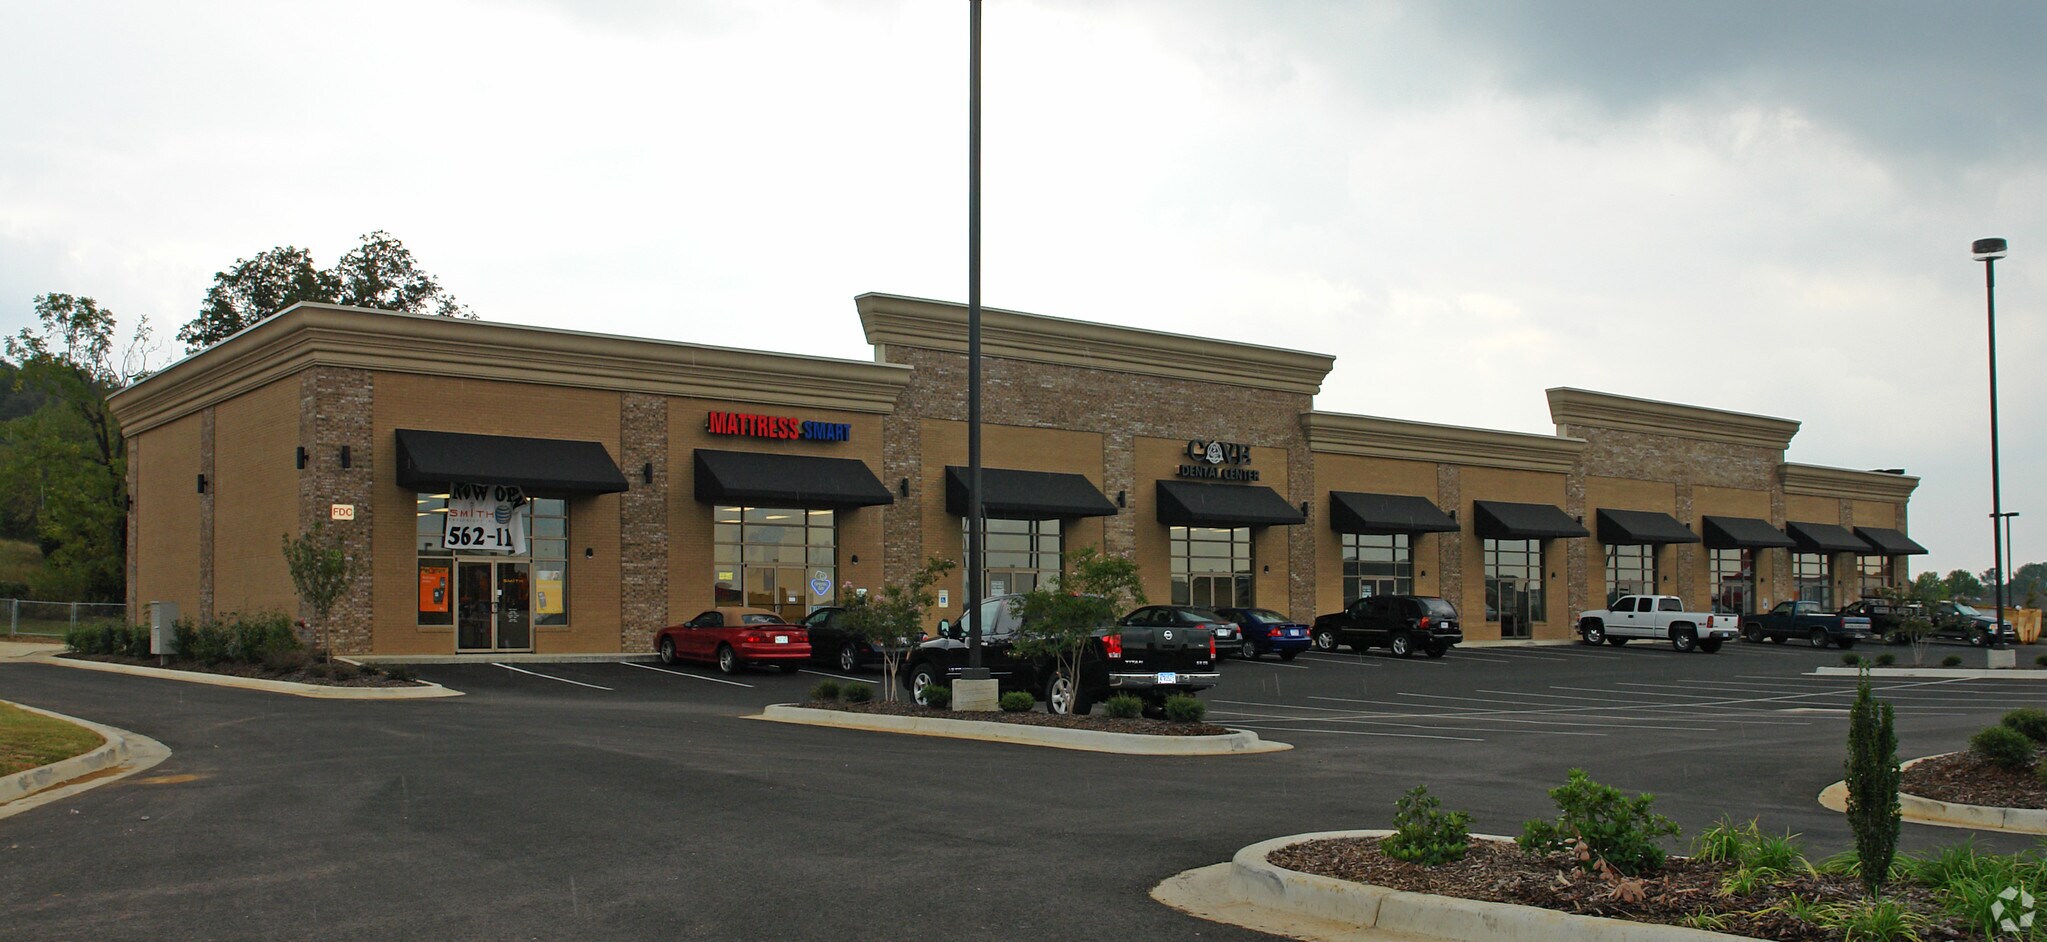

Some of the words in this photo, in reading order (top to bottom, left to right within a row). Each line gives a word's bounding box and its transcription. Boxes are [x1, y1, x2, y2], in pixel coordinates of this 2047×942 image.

[709, 411, 799, 440] MATTRESS
[803, 420, 851, 441] SMART
[1181, 465, 1222, 479] DENTAL
[1223, 468, 1260, 481] CENTER
[332, 507, 353, 517] FDC
[449, 508, 494, 519] SMITH
